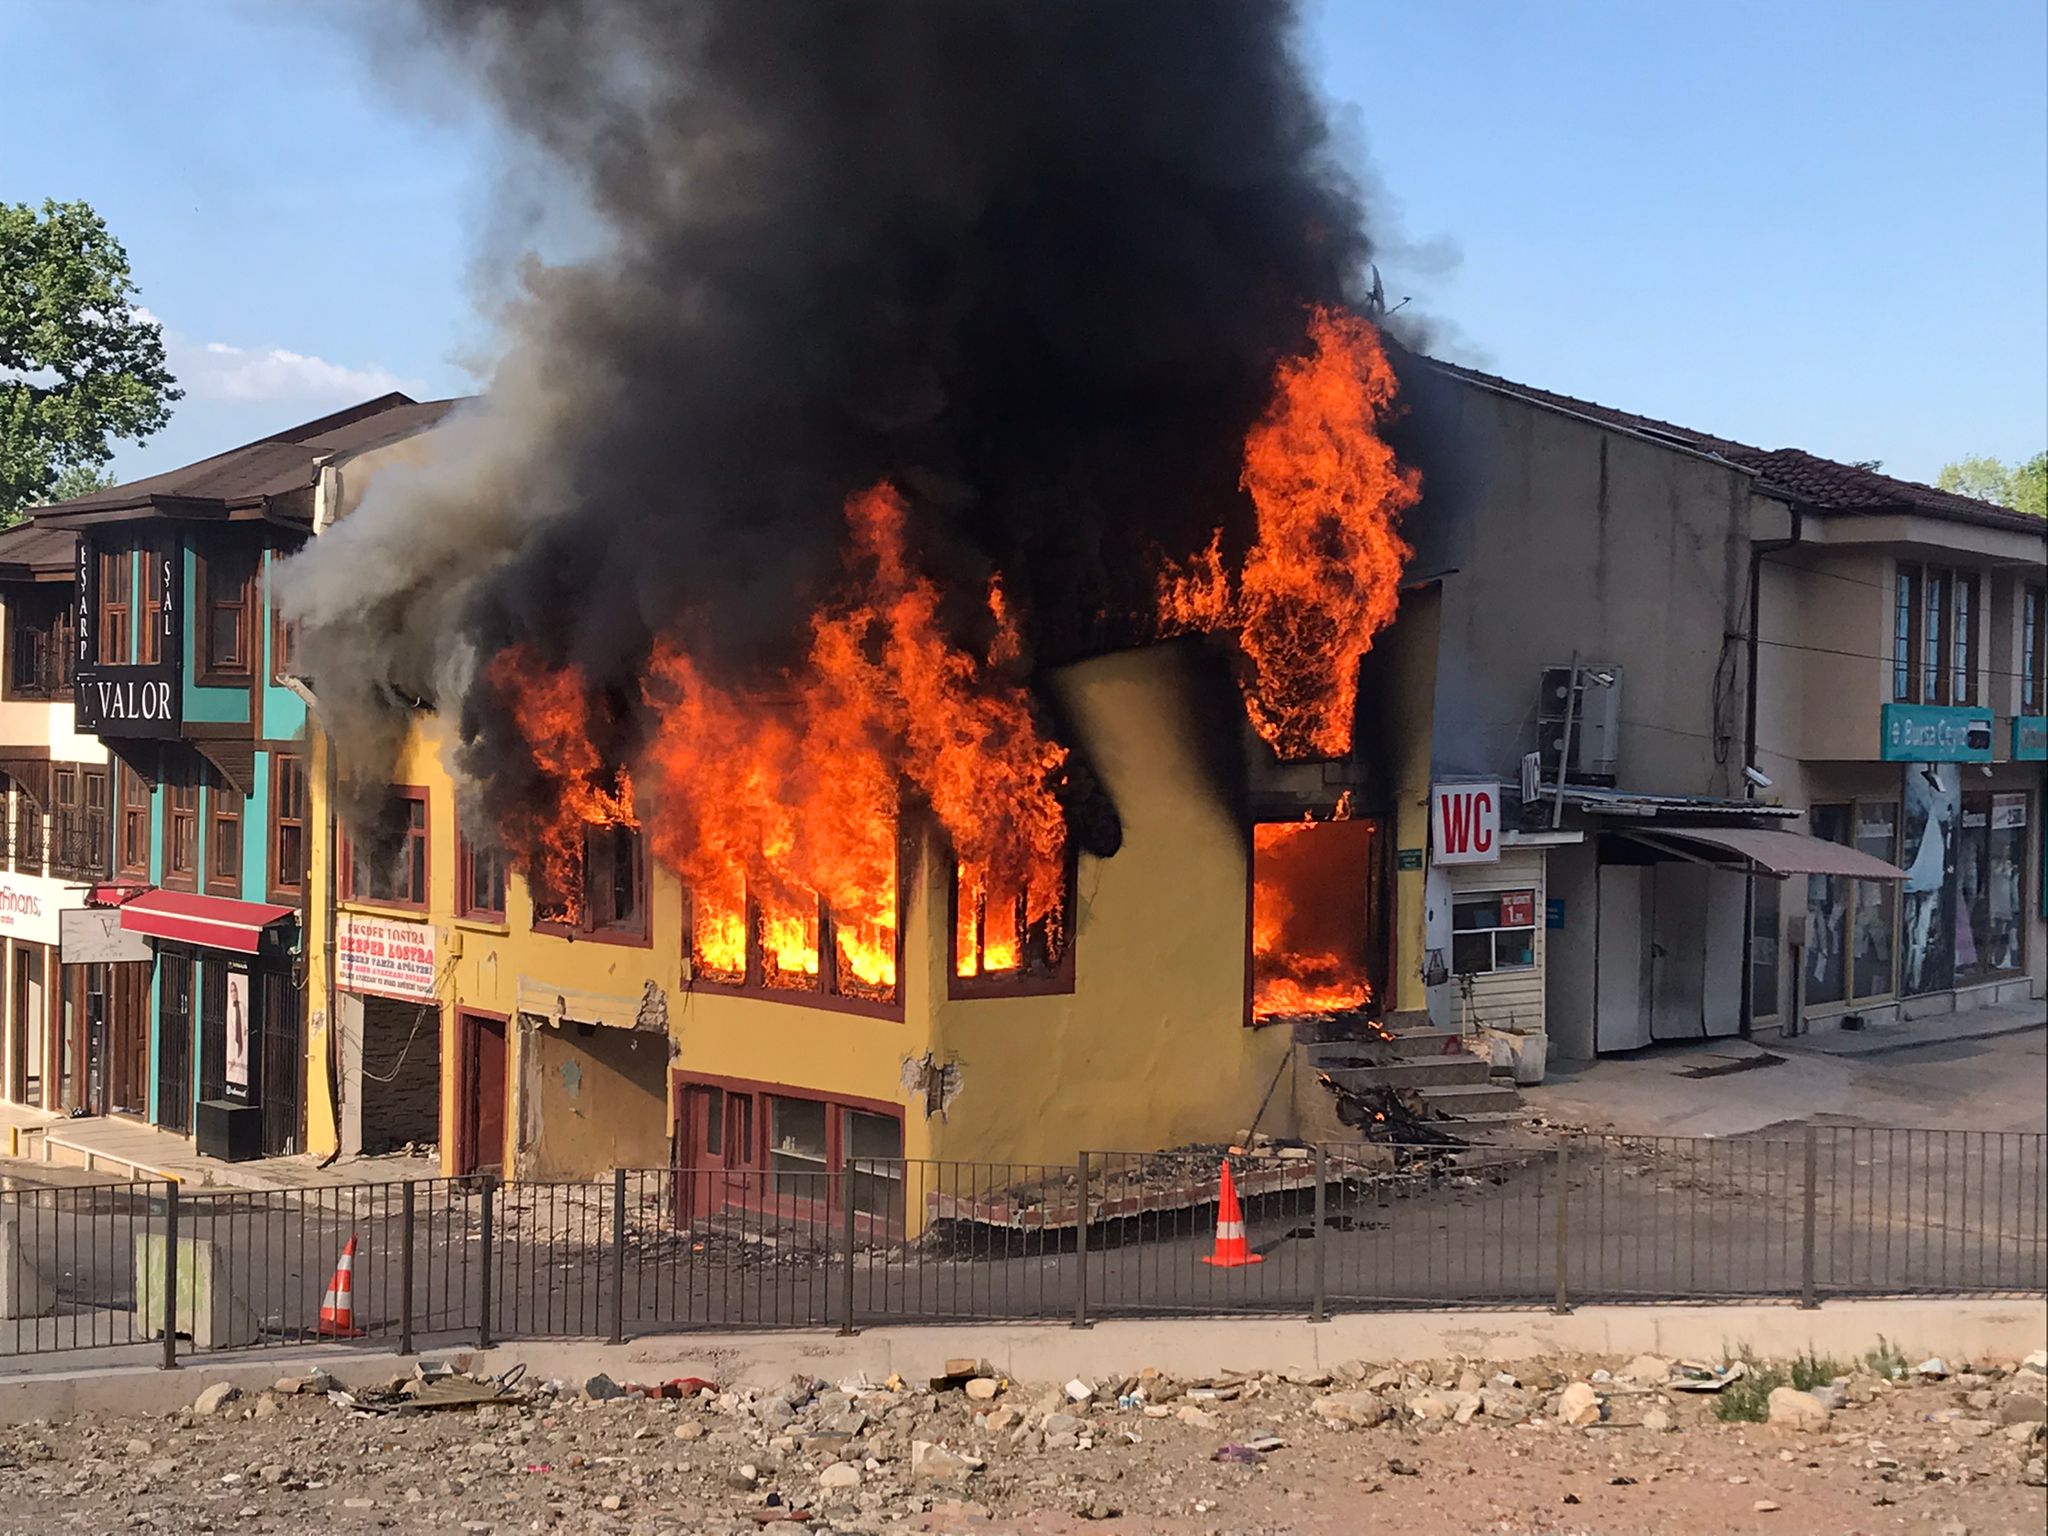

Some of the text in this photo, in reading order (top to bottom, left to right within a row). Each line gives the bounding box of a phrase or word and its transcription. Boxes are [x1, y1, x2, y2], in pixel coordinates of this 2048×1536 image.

[79, 545, 89, 660] EŞARP
[163, 561, 172, 636] ŞAL
[97, 681, 172, 720] VALOR
[1523, 756, 1541, 802] WC
[1441, 792, 1492, 854] WC
[340, 936, 434, 965] EKSPER LOSTRA
